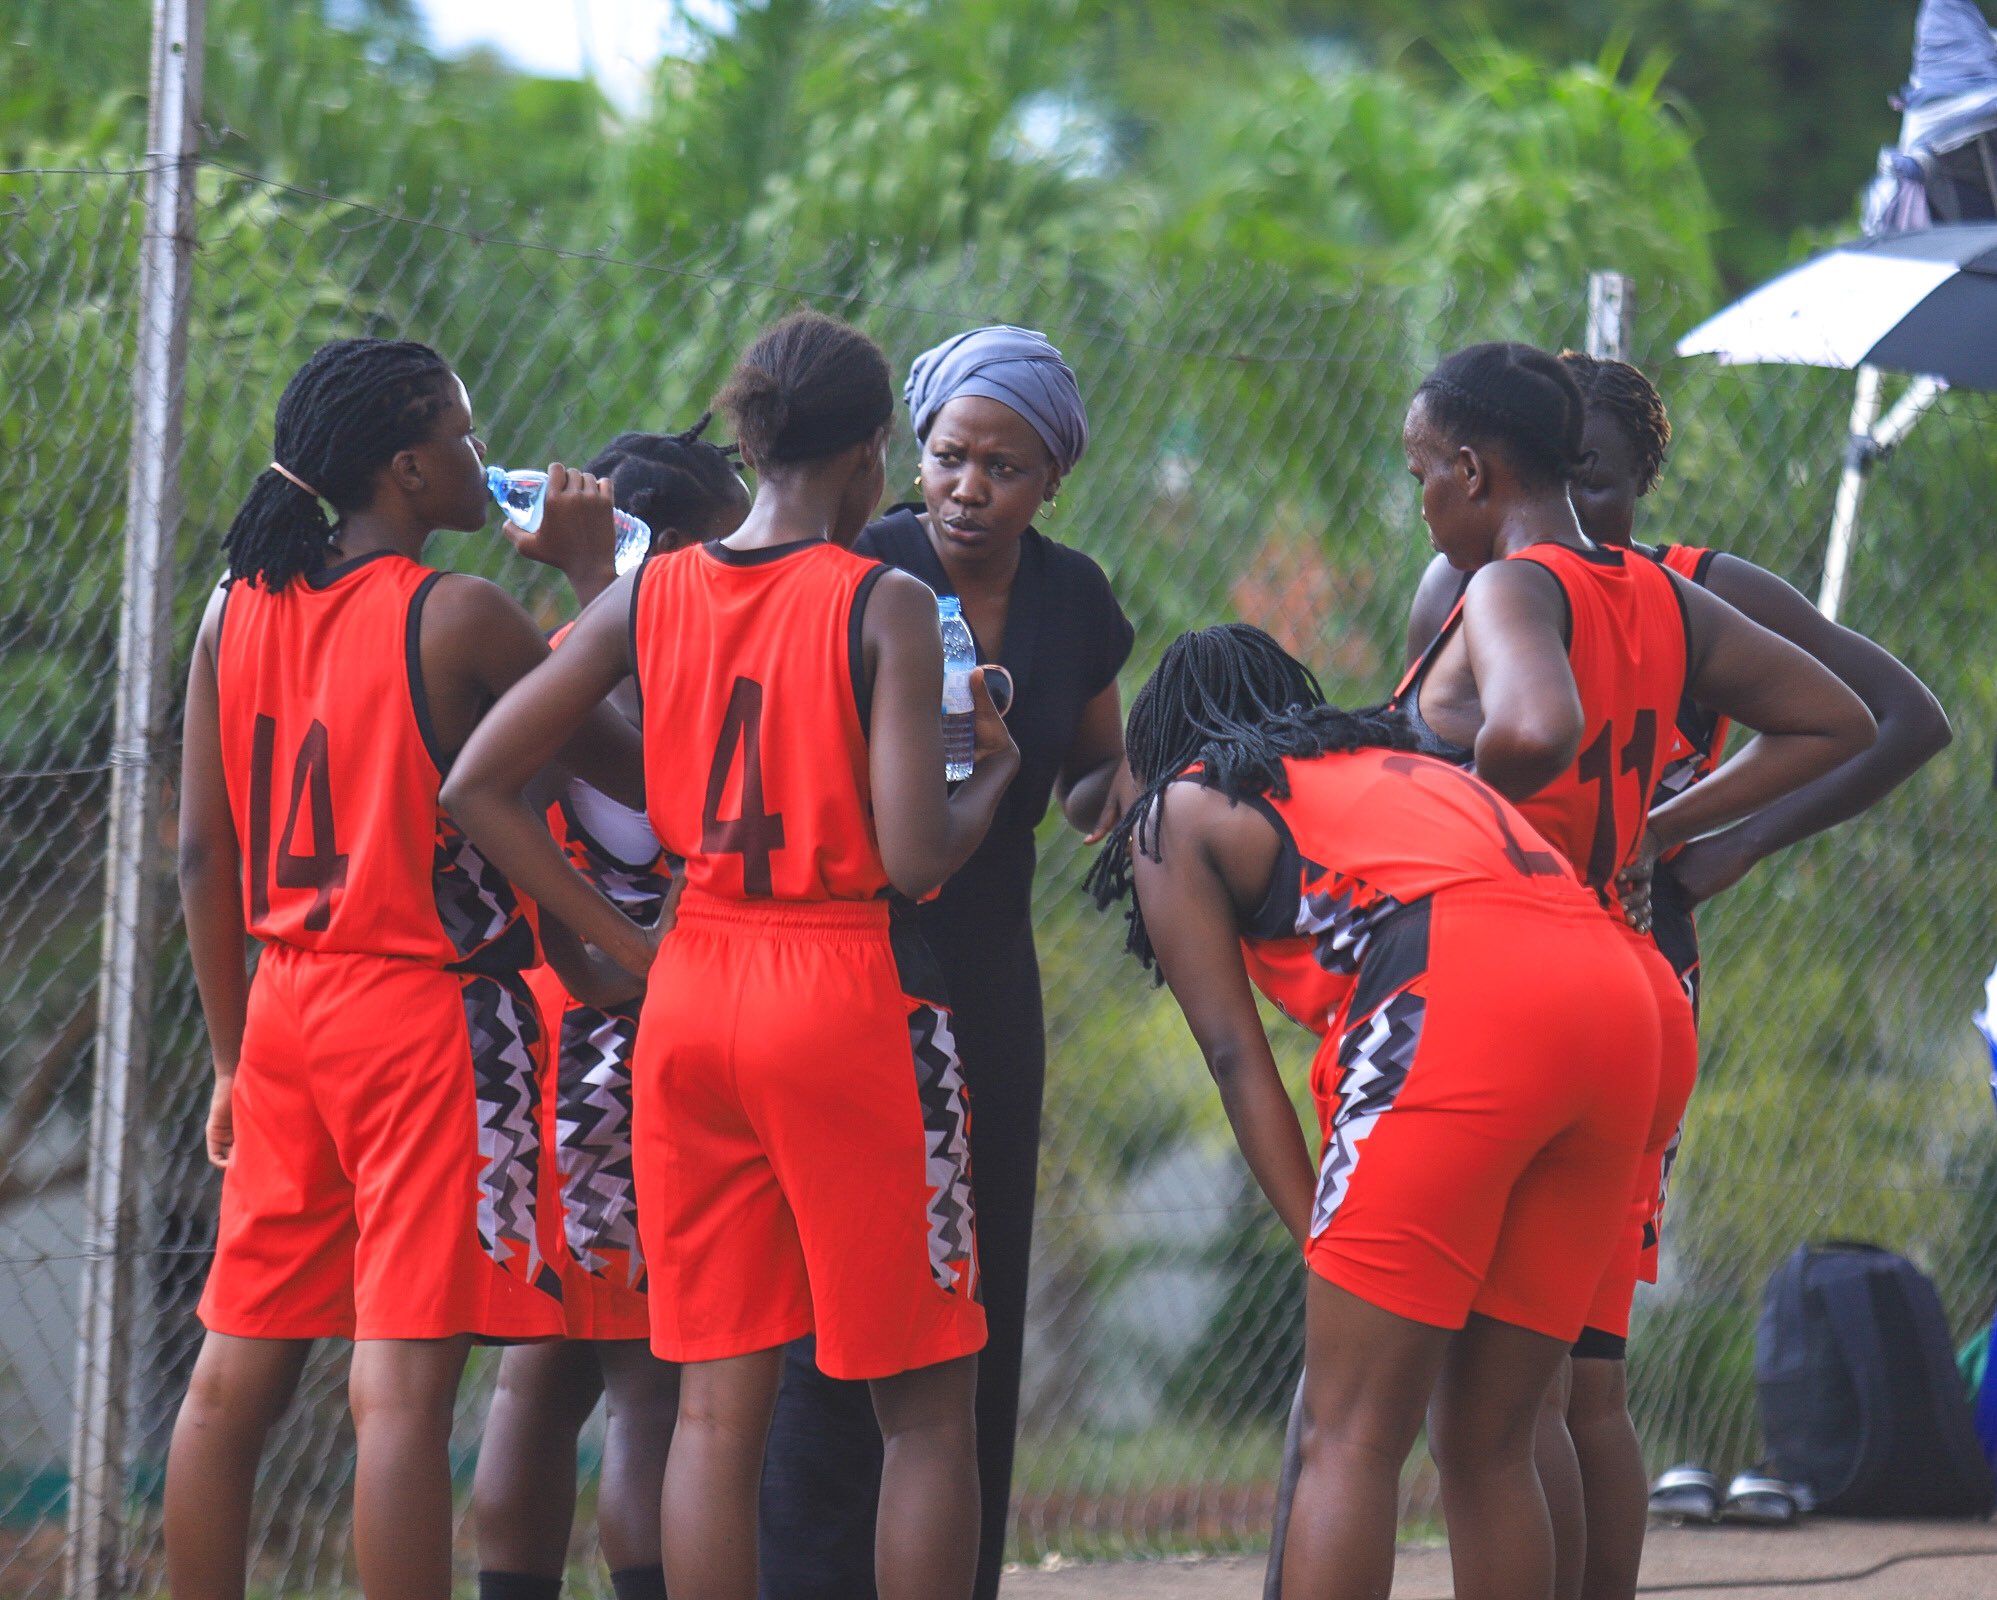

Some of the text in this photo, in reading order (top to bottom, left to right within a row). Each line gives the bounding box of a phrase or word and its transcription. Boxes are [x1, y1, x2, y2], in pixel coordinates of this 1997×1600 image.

[250, 712, 349, 931] 14
[701, 676, 785, 897] 4
[1578, 709, 1657, 911] 11
